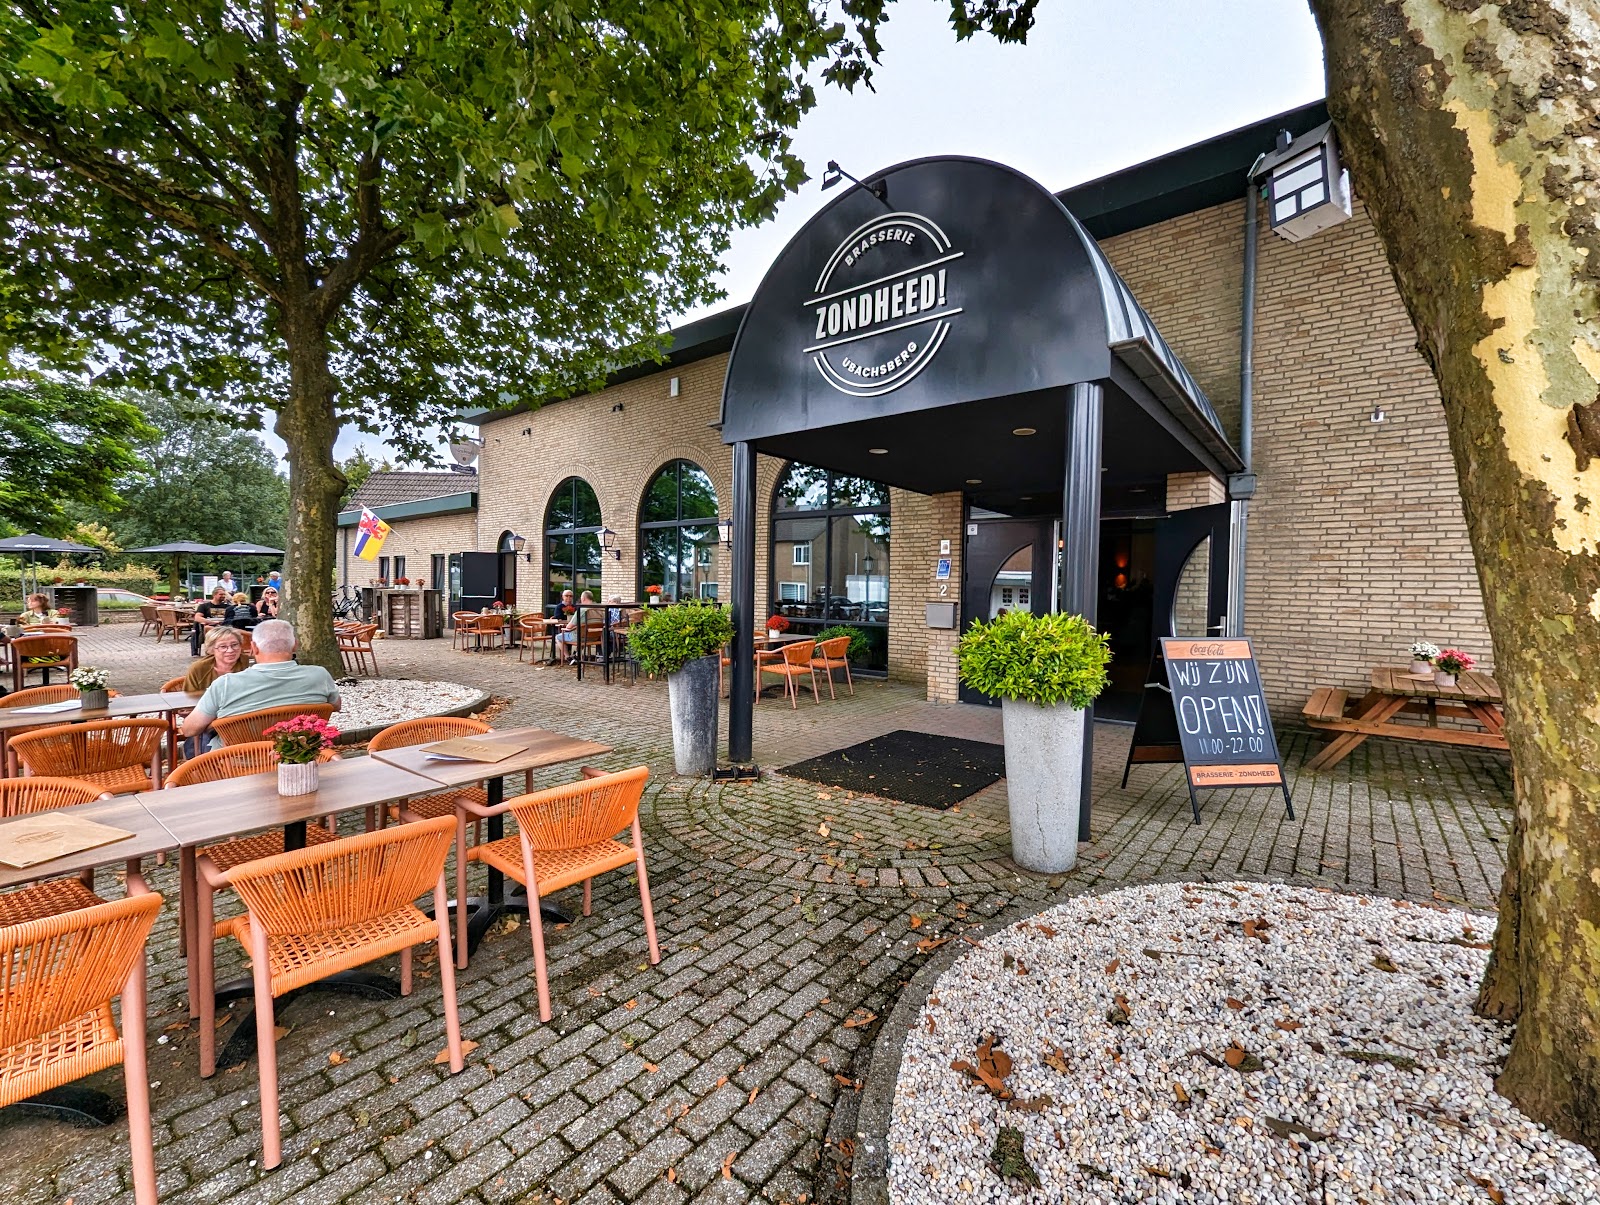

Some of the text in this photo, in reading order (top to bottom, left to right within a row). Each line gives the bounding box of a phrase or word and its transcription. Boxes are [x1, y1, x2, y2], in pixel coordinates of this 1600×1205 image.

[844, 228, 916, 267] BRASSERIE
[815, 268, 947, 340] ZONDHEED!
[842, 341, 918, 377] UBACHSBERG
[940, 584, 948, 596] 2
[1179, 695, 1265, 735] OPEN!
[1196, 771, 1234, 779] BRASSERIE
[1238, 770, 1275, 778] ZONDHEED
